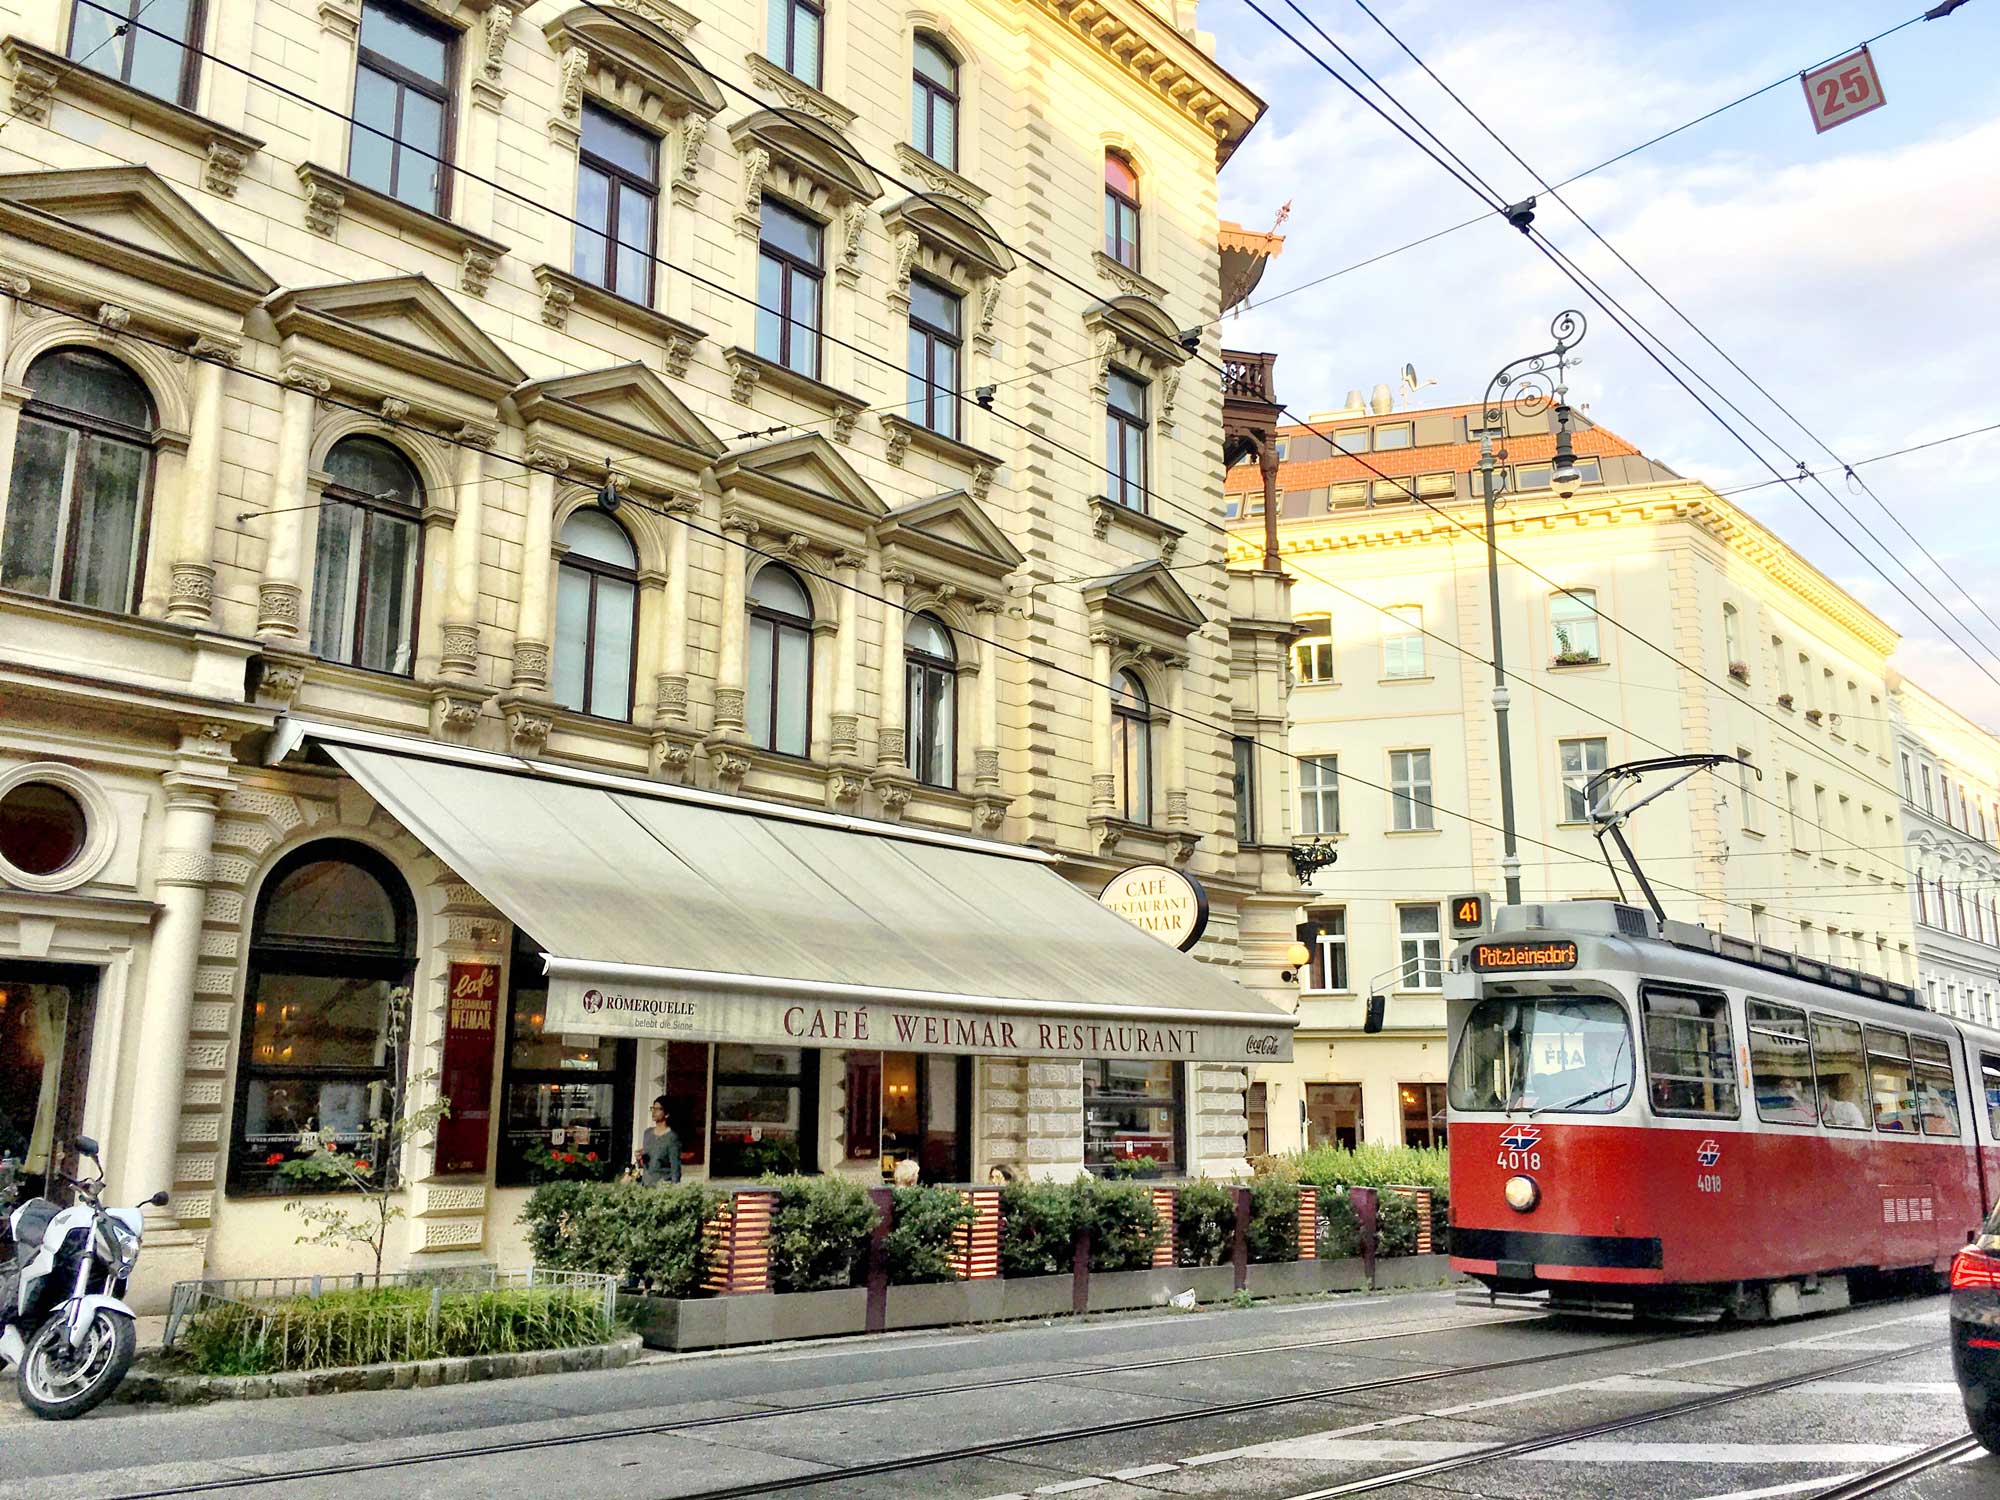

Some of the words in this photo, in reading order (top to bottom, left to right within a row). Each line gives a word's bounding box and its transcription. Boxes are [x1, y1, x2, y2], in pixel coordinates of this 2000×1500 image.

[1816, 66, 1869, 116] 25
[1126, 876, 1168, 897] CAFÉ
[1460, 902, 1478, 922] 41
[1480, 945, 1576, 967] Pötzleinsdorf
[453, 968, 494, 998] Café
[606, 994, 695, 1016] RÖMERQUELLE
[451, 1009, 491, 1030] WEIMAR
[783, 1006, 869, 1041] CAFÉ
[892, 1014, 1018, 1049] WEIMAR
[1038, 1024, 1198, 1054] RESTAURANT
[1497, 1151, 1541, 1171] 4018
[1697, 1174, 1722, 1193] 4018
